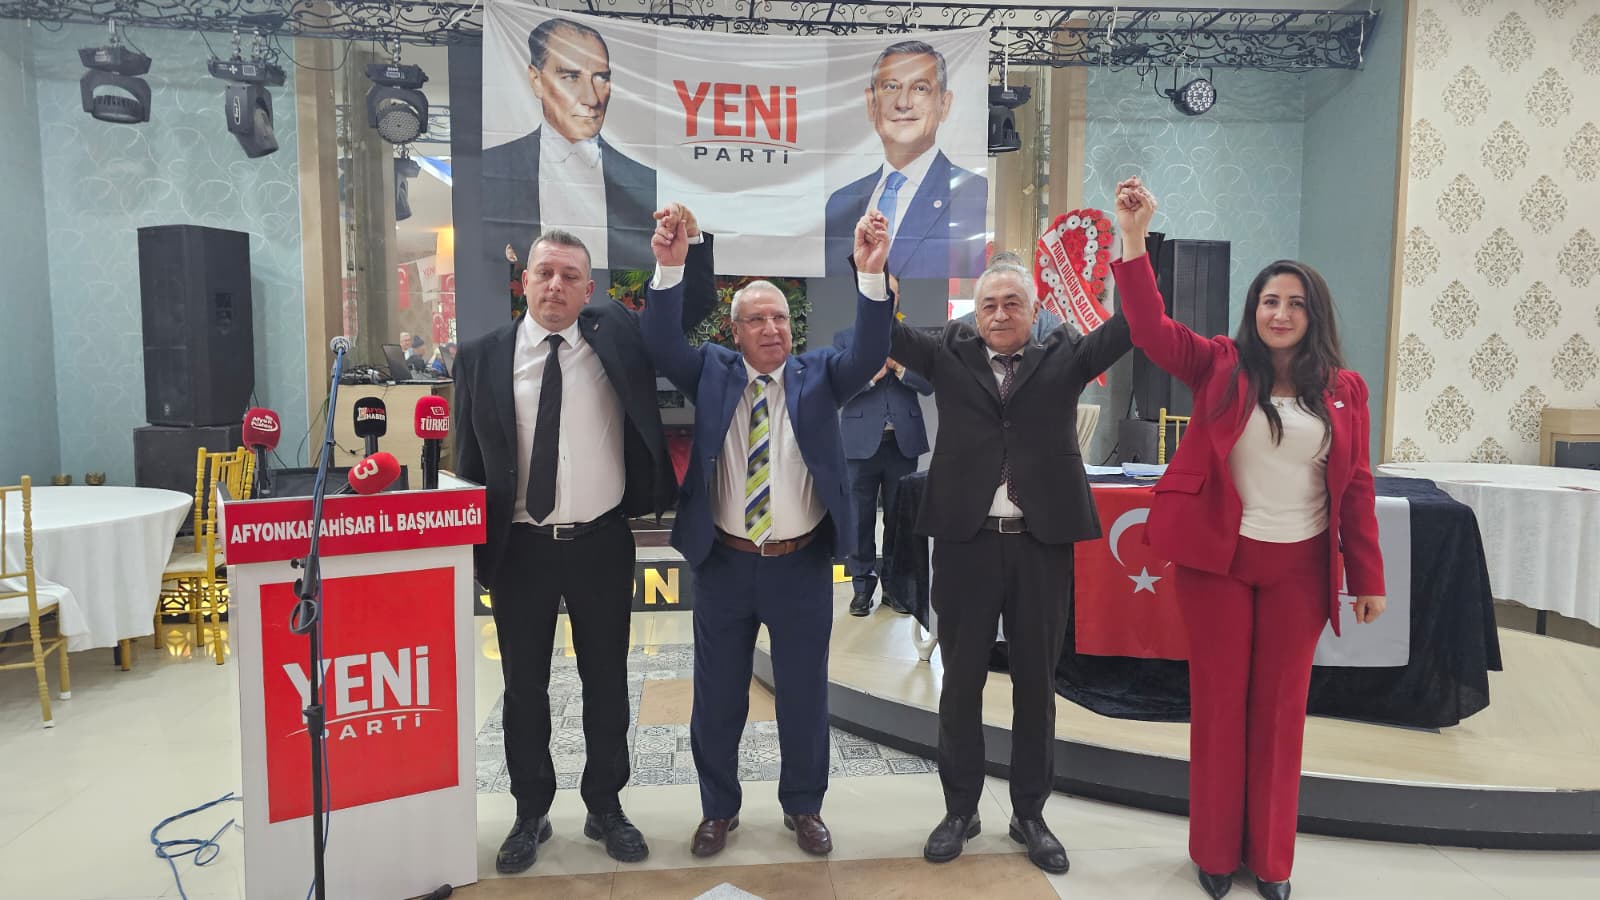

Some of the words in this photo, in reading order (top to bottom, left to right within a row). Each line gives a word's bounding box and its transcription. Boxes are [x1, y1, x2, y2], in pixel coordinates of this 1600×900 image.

[1050, 240, 1066, 266] FUAR
[1074, 295, 1100, 328] SALON
[353, 458, 379, 480] 3
[379, 509, 393, 533] İL
[397, 503, 482, 535] BAŞKANLIĞI
[319, 713, 421, 741] ARTİ
